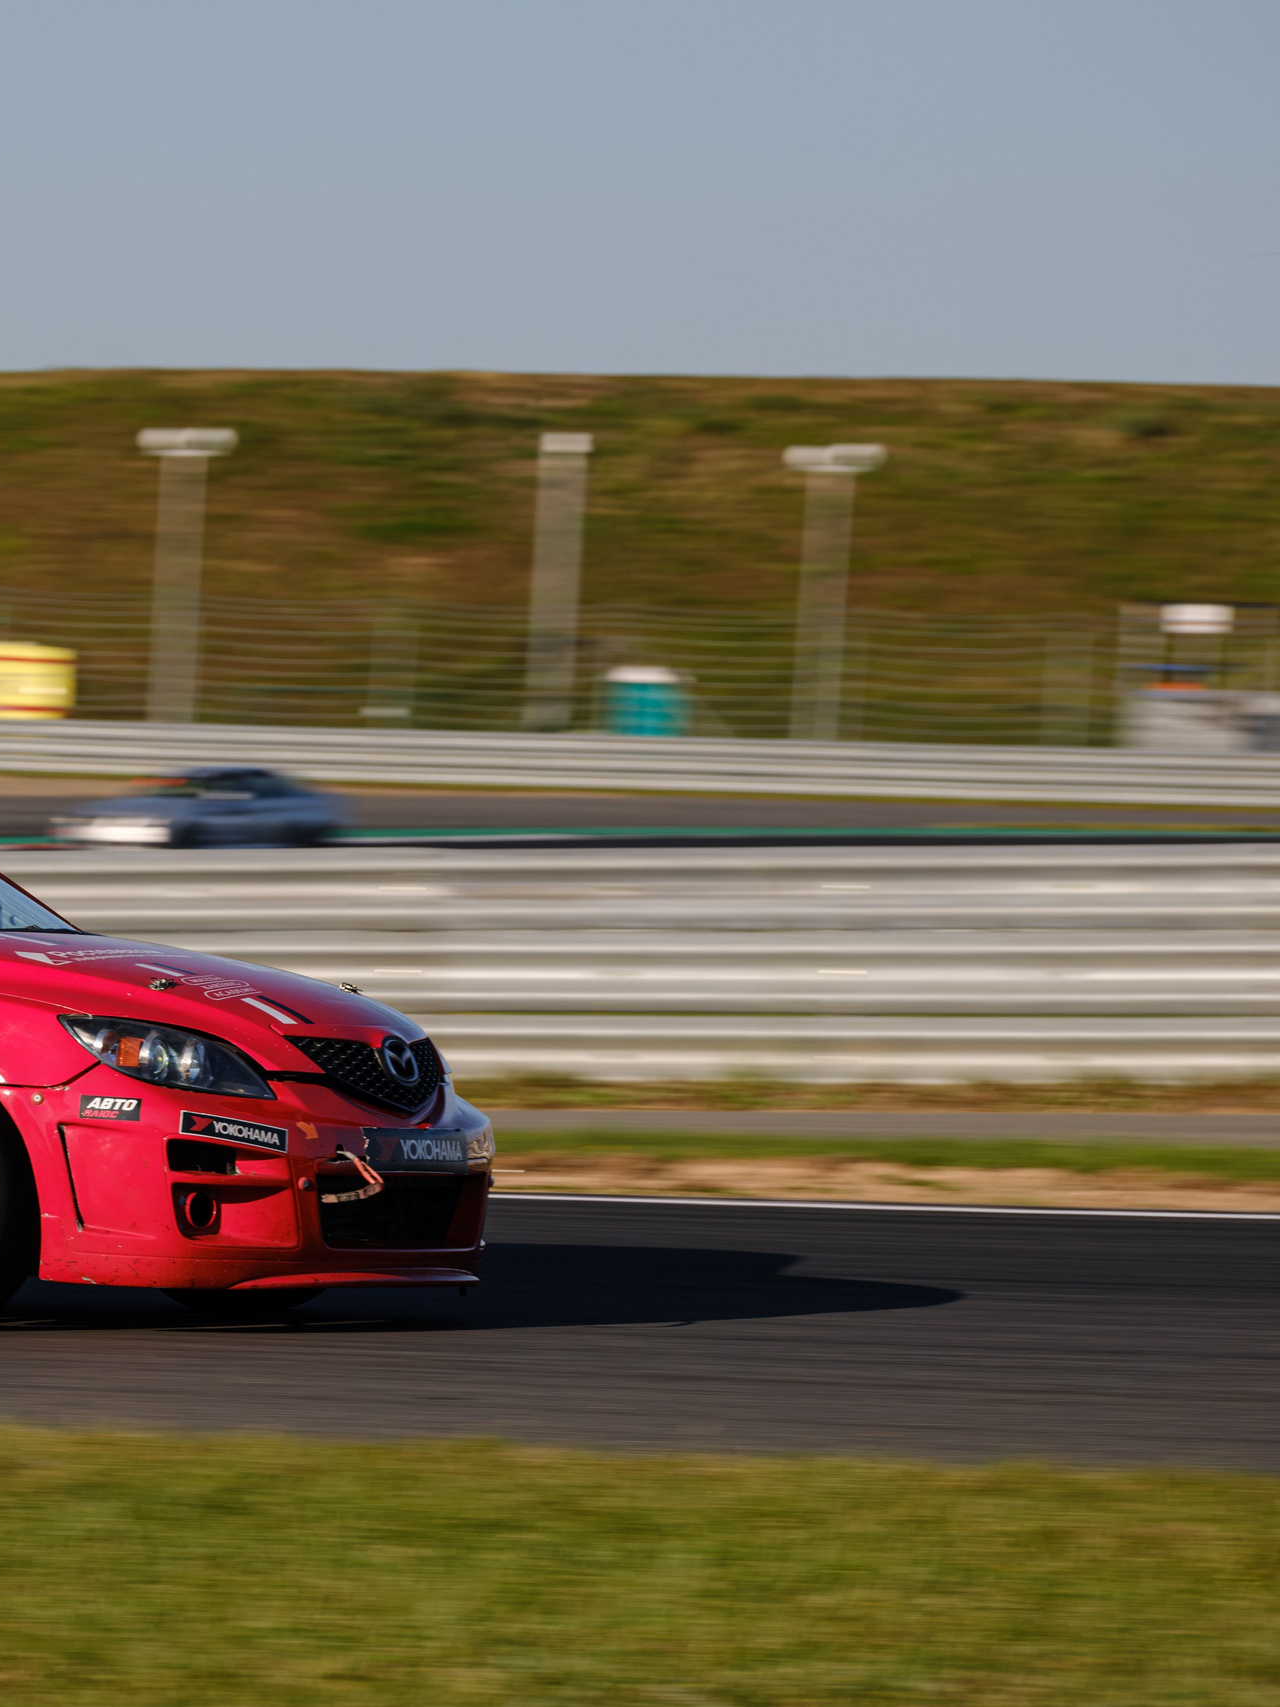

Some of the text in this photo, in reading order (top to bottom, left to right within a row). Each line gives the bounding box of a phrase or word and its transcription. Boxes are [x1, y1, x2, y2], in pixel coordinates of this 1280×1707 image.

[86, 1097, 138, 1111] АВТО
[83, 1109, 120, 1119] ПЛЮС
[213, 1119, 280, 1146] YOKOHAMA
[400, 1138, 464, 1161] YOKOHAMA
